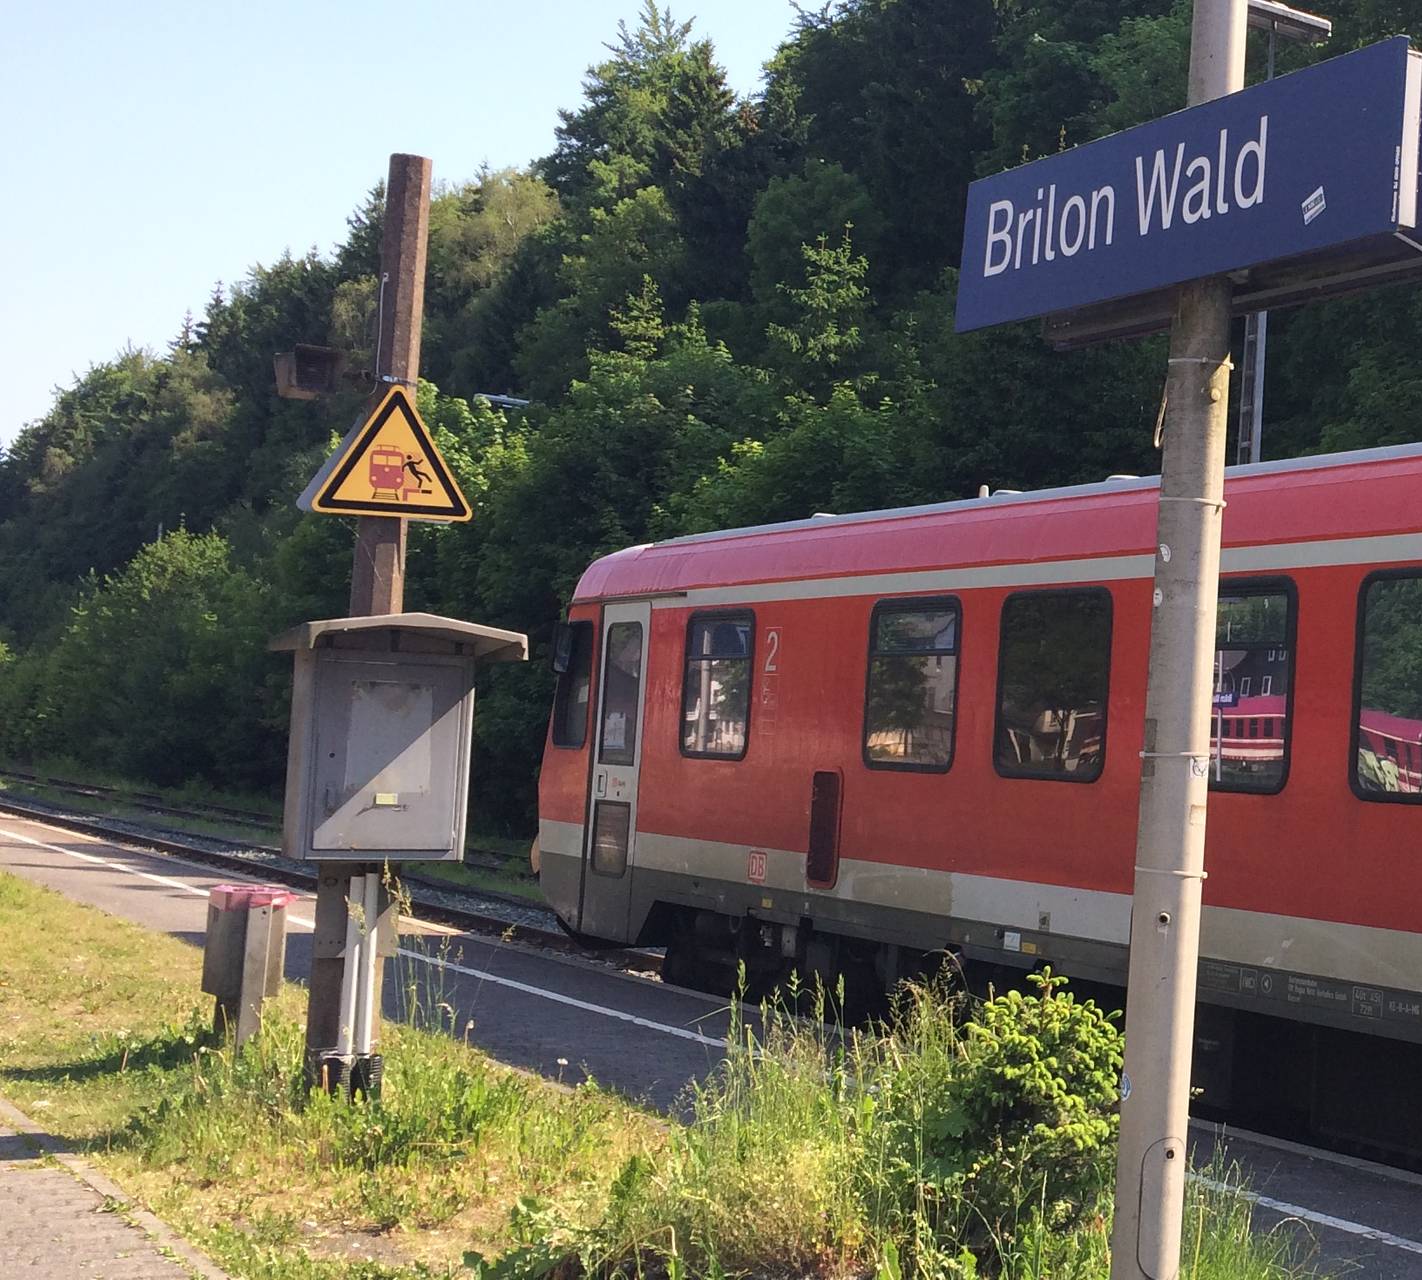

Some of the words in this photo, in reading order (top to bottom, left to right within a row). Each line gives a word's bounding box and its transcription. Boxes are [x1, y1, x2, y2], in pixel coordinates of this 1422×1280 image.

[983, 183, 1114, 277] Brilon
[1135, 115, 1268, 236] Wald
[765, 631, 779, 672] 2
[751, 855, 765, 877] DB
